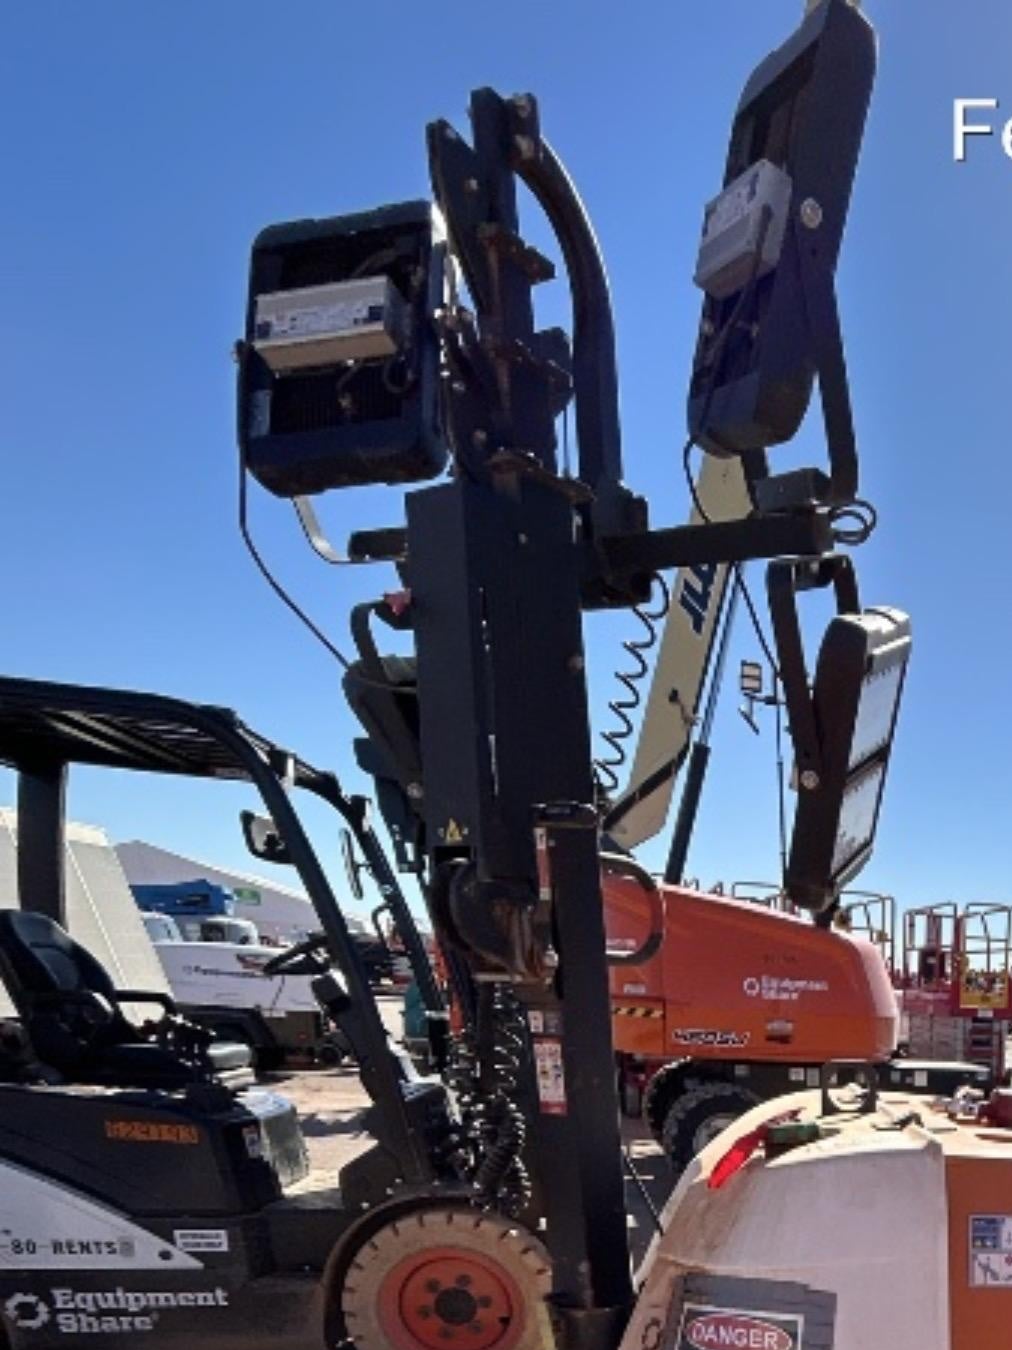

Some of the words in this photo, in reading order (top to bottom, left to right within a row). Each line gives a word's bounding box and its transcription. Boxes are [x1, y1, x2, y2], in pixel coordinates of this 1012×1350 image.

[51, 1286, 229, 1312] Equipment
[56, 1311, 154, 1333] Share
[691, 1322, 779, 1350] DANGER
